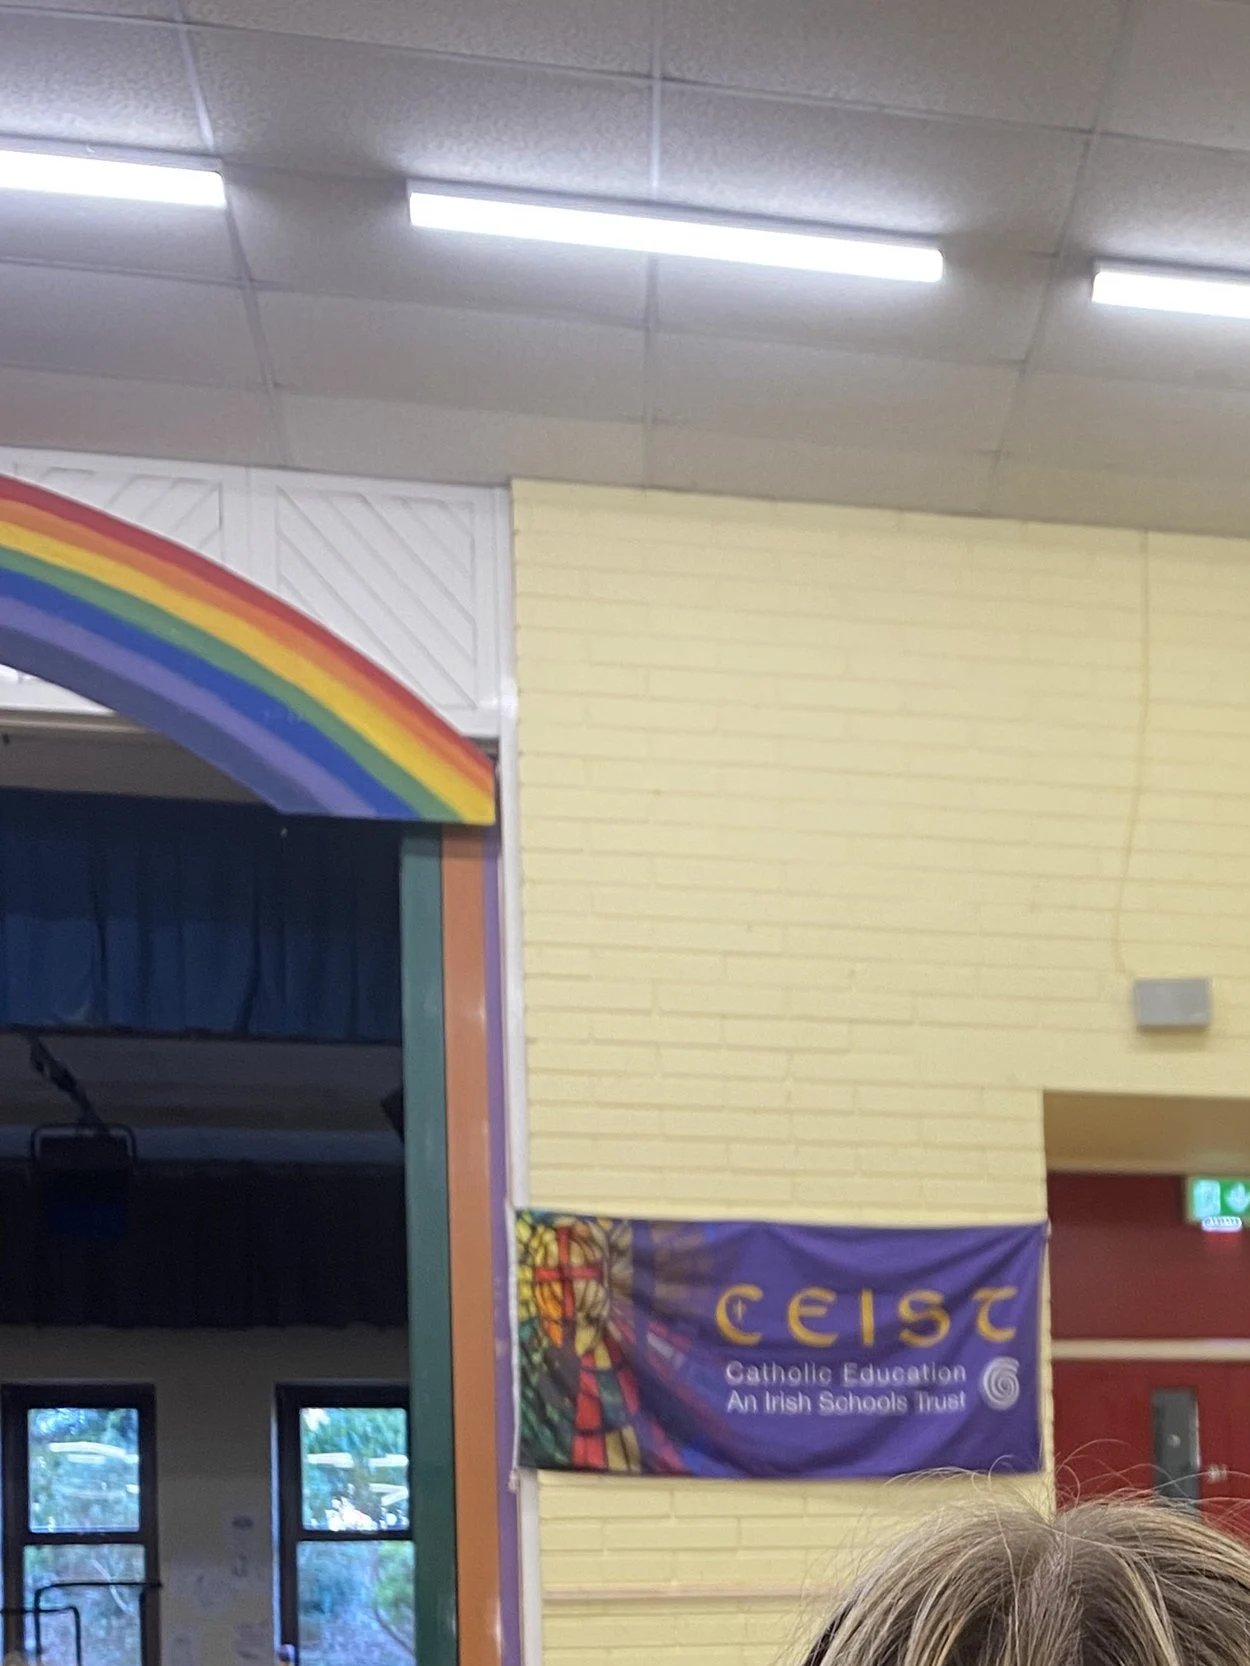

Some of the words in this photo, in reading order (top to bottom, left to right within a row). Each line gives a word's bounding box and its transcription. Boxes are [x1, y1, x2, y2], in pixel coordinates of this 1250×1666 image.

[715, 1284, 1018, 1348] CEIST
[726, 1361, 832, 1385] Catholic
[843, 1362, 966, 1386] Education
[727, 1391, 757, 1412] An
[765, 1390, 811, 1412] Irish
[819, 1391, 908, 1412] Schools
[916, 1390, 966, 1411] Trust
